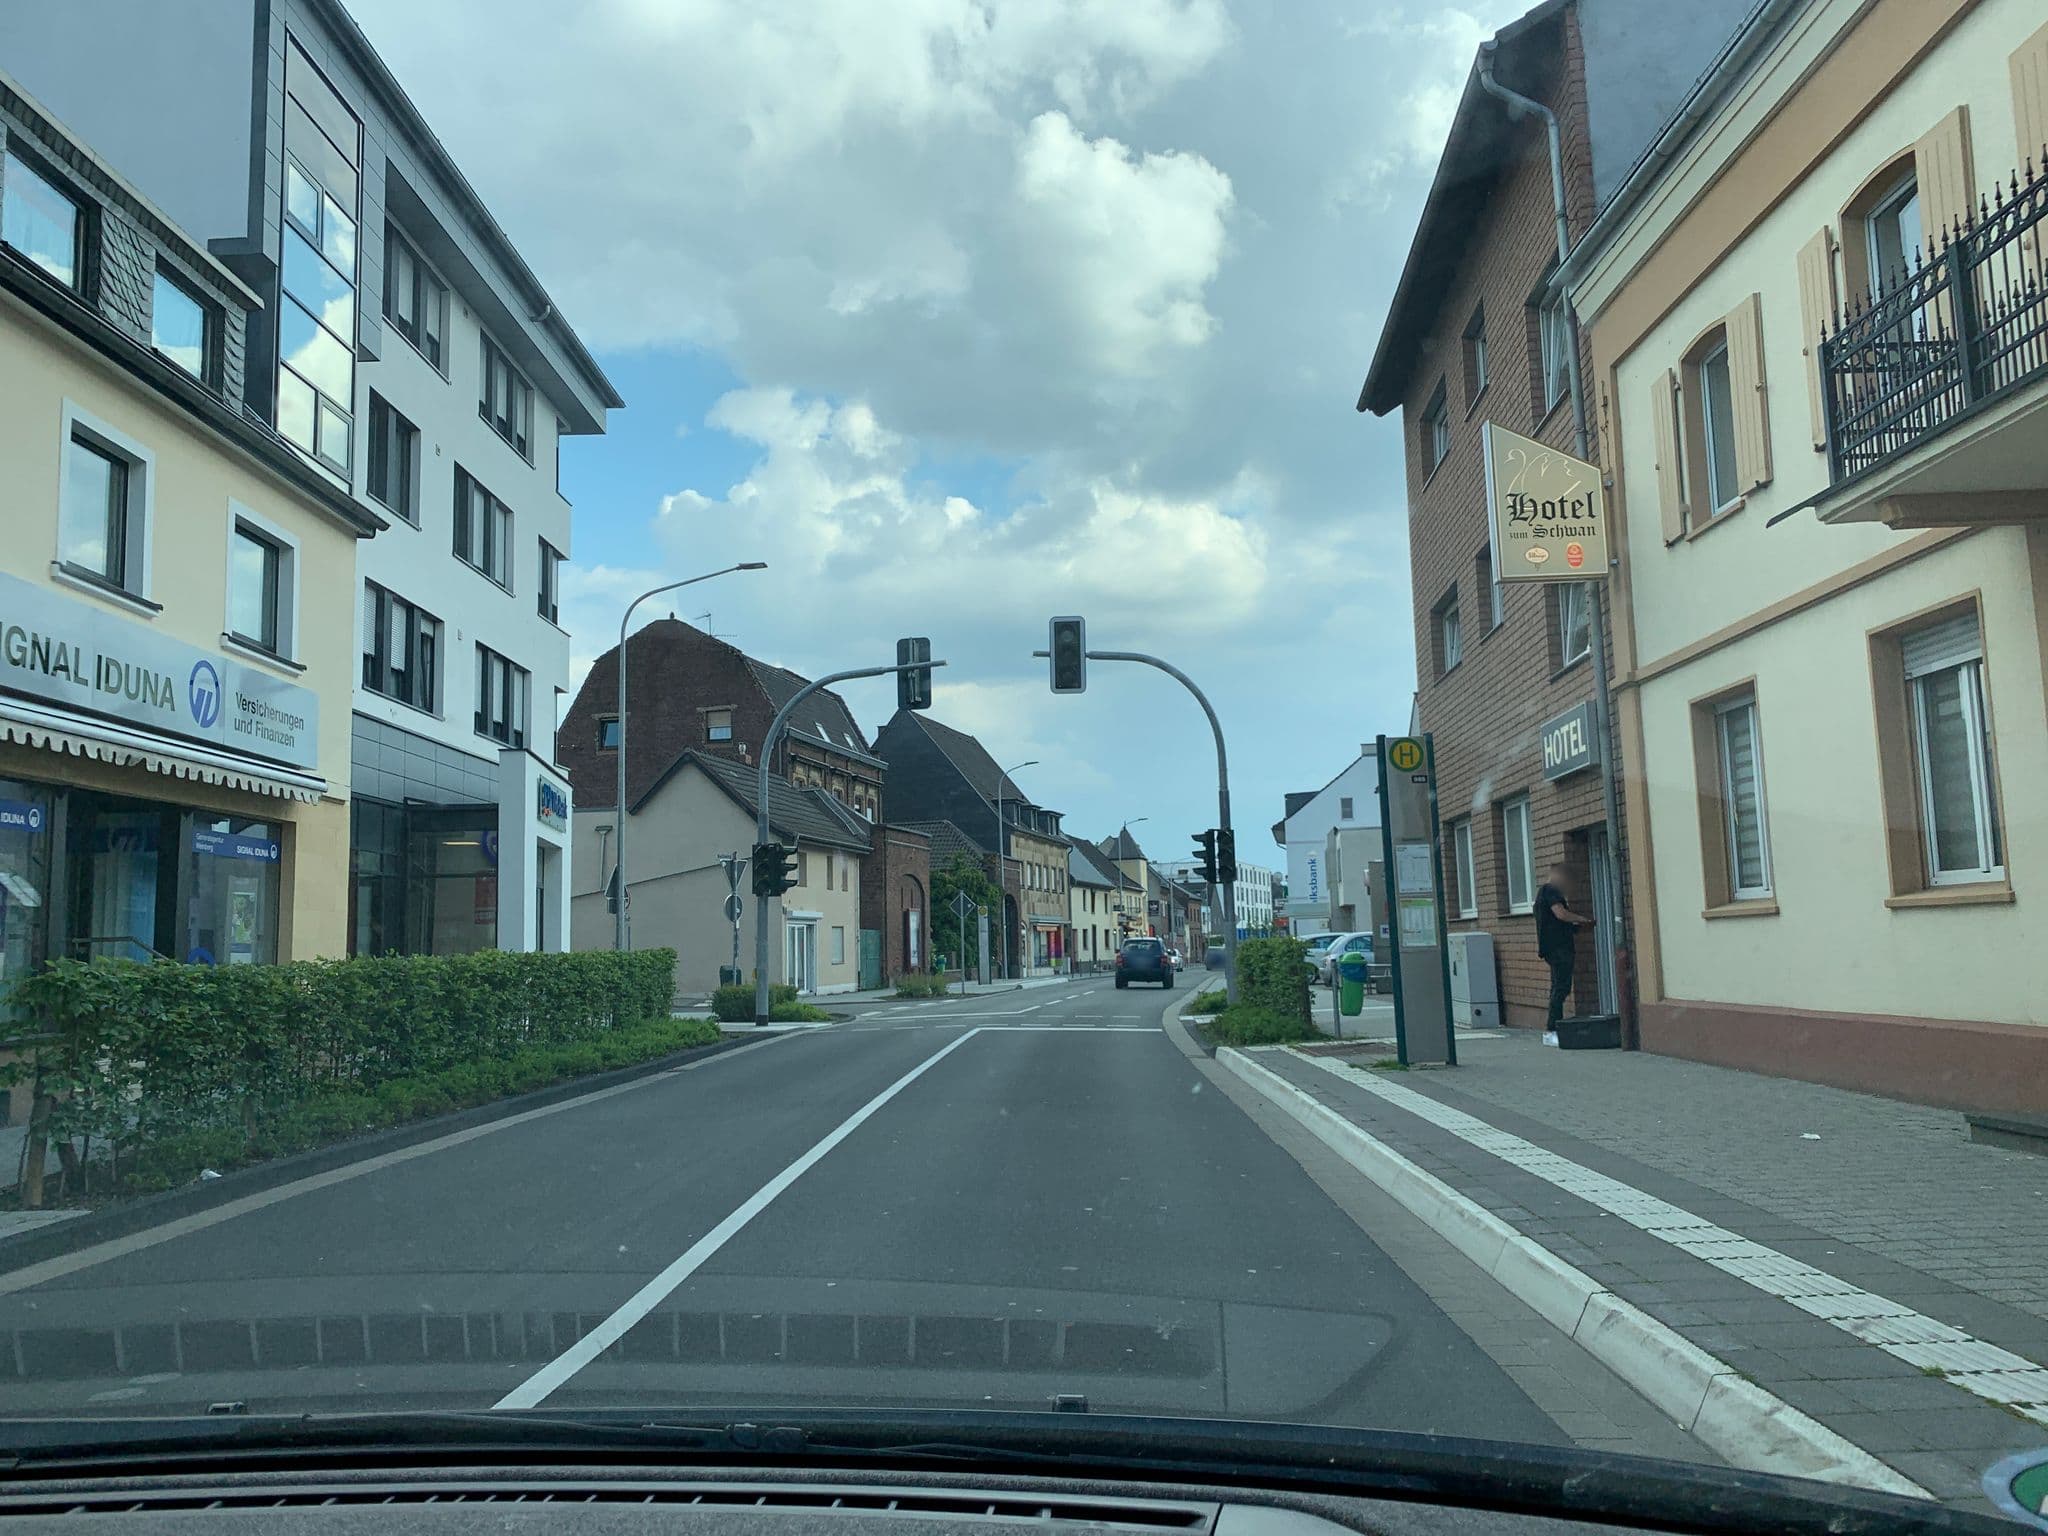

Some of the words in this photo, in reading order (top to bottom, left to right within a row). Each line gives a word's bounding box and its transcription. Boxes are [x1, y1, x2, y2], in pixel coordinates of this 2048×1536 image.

[1505, 491, 1597, 526] Hotel
[1532, 524, 1596, 540] Schwan
[96, 654, 176, 712] IDUNA
[235, 691, 304, 730] Versicherungen
[234, 717, 252, 735] und
[255, 720, 295, 747] Finanzen
[1543, 717, 1587, 769] HOTEL
[1400, 744, 1414, 765] H
